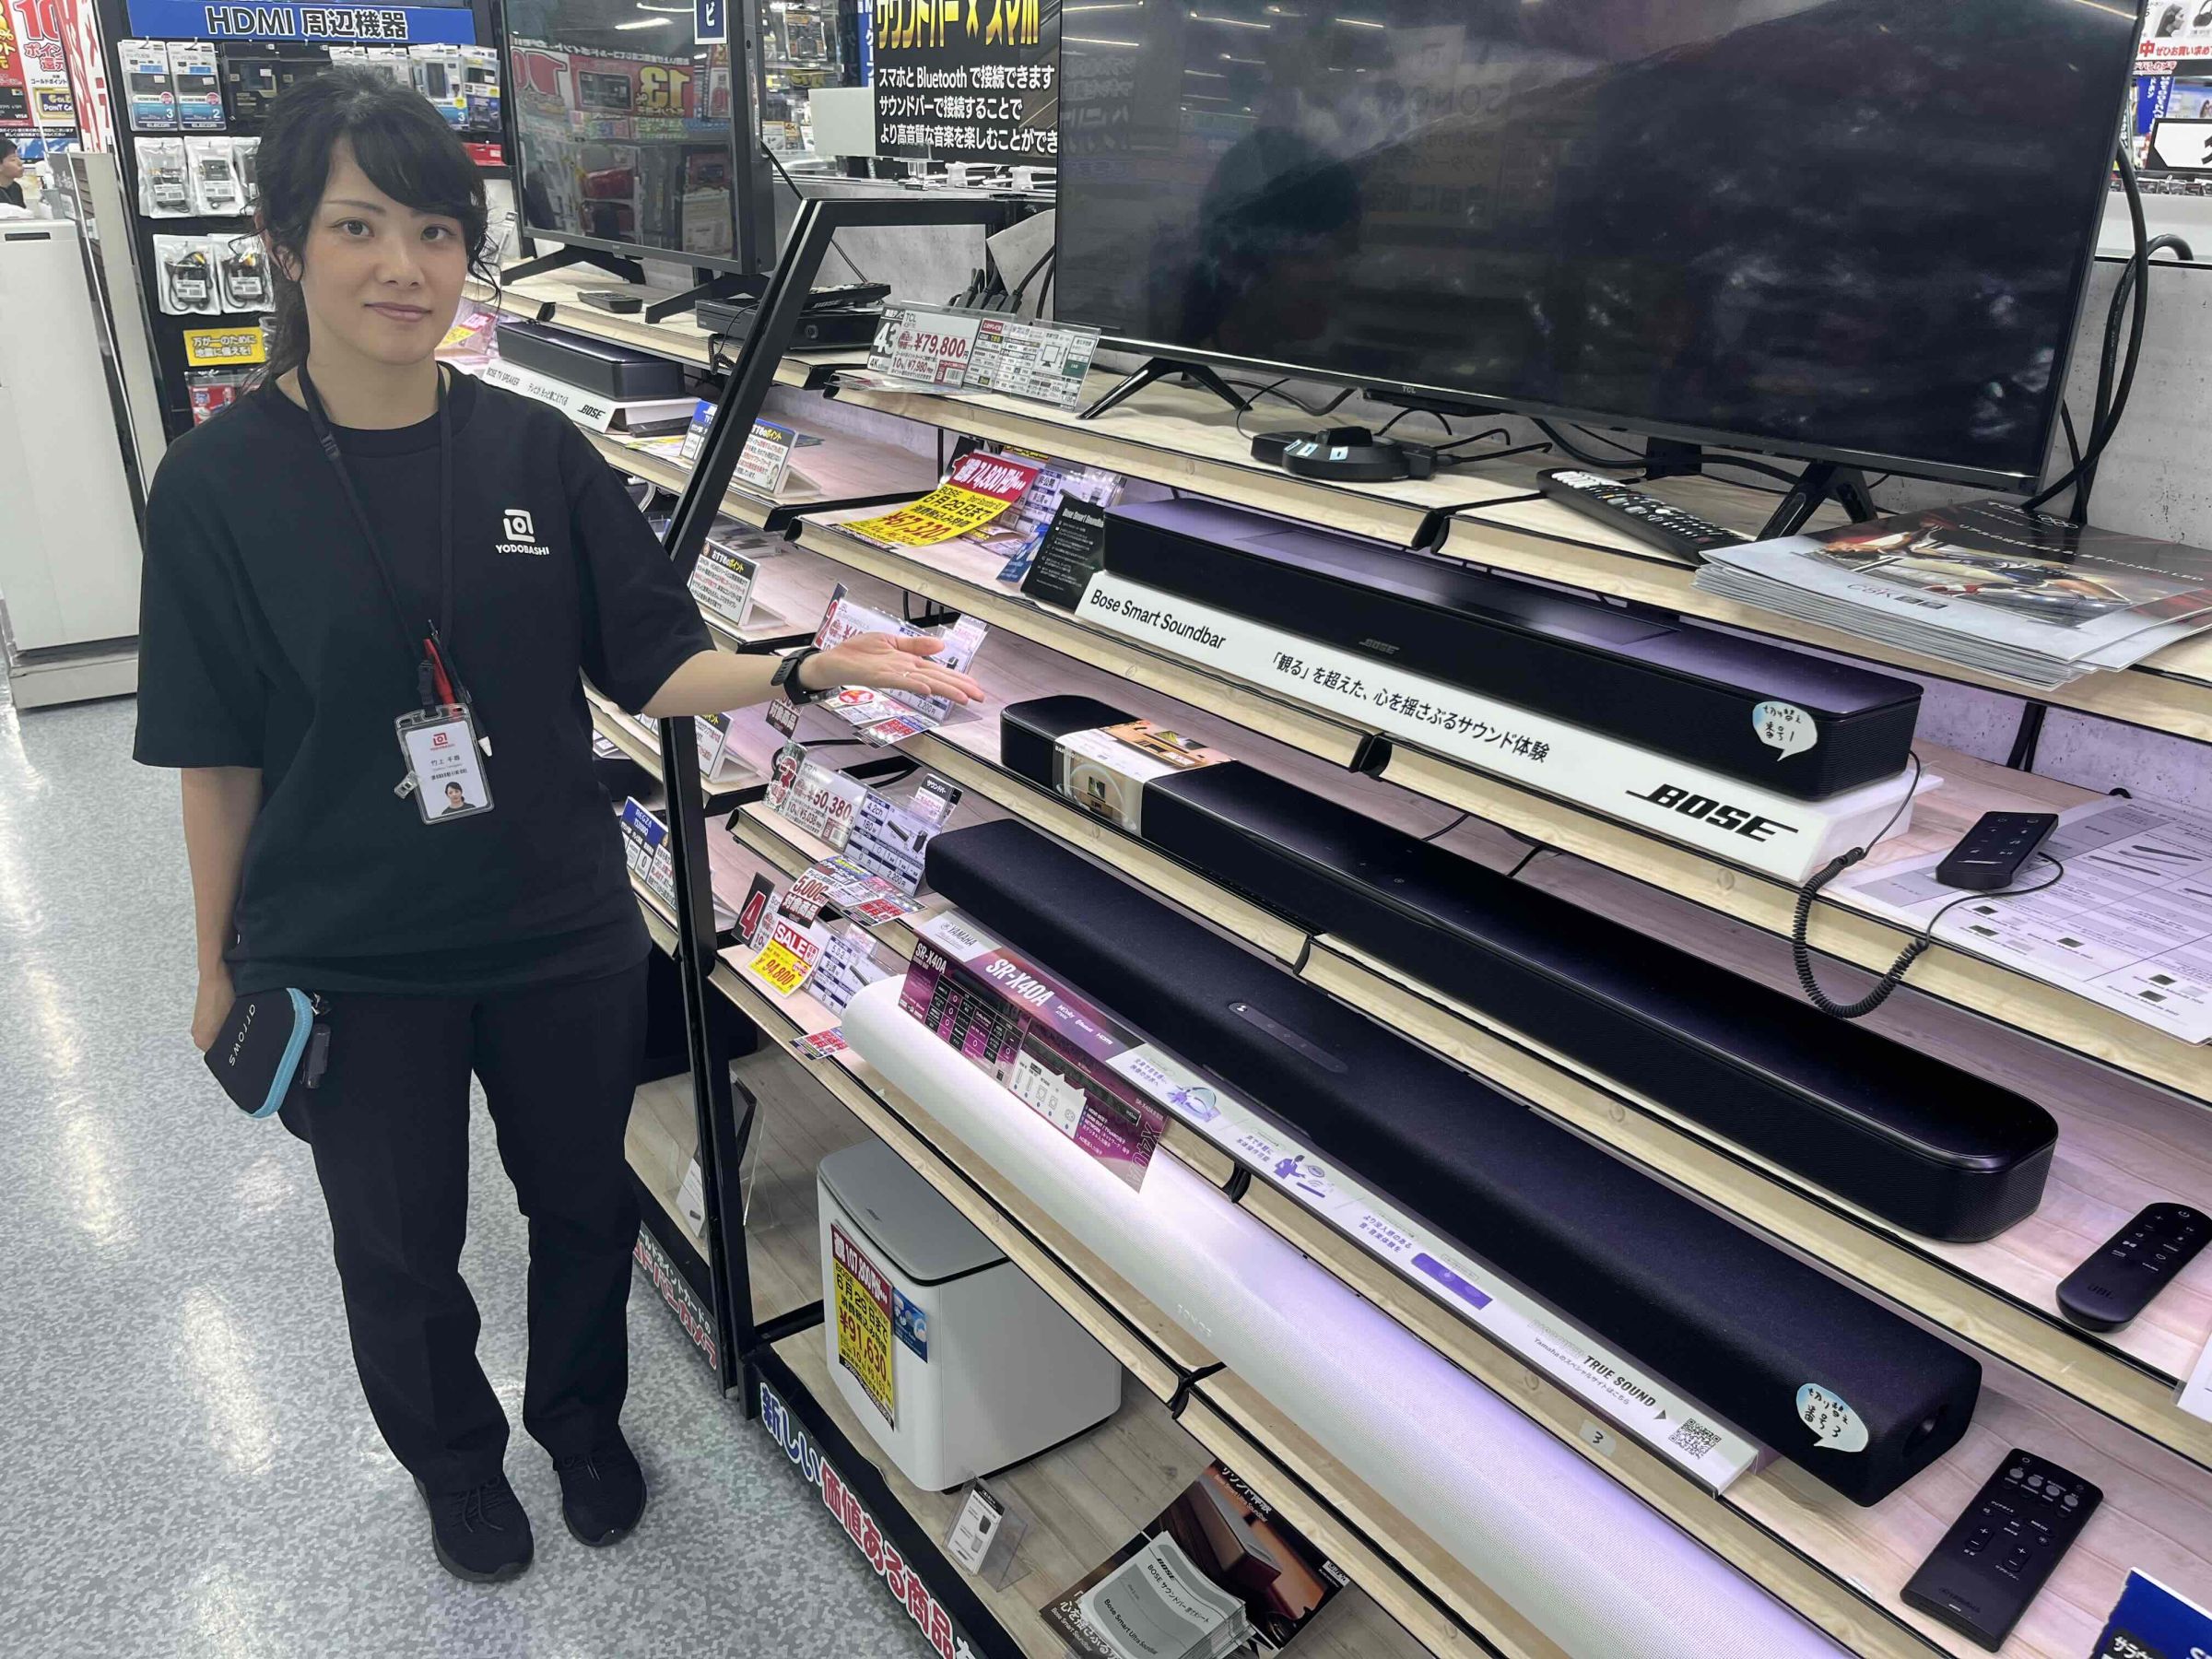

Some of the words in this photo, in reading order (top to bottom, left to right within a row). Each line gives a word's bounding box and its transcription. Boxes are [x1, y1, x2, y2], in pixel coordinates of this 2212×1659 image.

[207, 7, 295, 37] HDMI
[301, 7, 408, 39] 周辺機器
[879, 66, 914, 88] スマホと
[917, 65, 967, 88] Bluetooth
[970, 65, 1055, 89] で接続できます
[166, 108, 174, 118] 3
[212, 109, 221, 119] 2
[458, 112, 465, 122] 3
[879, 95, 1022, 121] サウンドバーで接続することで
[880, 124, 1058, 154] より高音質な音楽を楽しむことができ
[906, 312, 916, 323] TCL
[193, 335, 256, 347] 万が一のために
[874, 323, 900, 355] 43
[577, 405, 606, 419] BOSE
[495, 544, 549, 556] YODOBASHI
[1090, 589, 1120, 614] Bose
[1122, 599, 1161, 628] Smart
[1161, 614, 1227, 650] Soundbar
[1359, 639, 1400, 654] BOSE
[635, 808, 653, 829] REGZA
[1626, 783, 1799, 842] BOSE
[739, 890, 767, 939] 4
[774, 924, 807, 958] SALE
[948, 922, 977, 947] YAMAHA
[915, 943, 947, 974] SR-X40A
[986, 959, 1054, 1007] SR-X40A
[1583, 1354, 1616, 1382] TRUE
[1612, 1374, 1657, 1408] SOUND
[1593, 1431, 1604, 1443] 3
[1157, 1558, 1176, 1581] BOSE
[1147, 1564, 1162, 1583] BOSE
[1161, 1582, 1187, 1611] サウンドバー
[1104, 1598, 1117, 1616] Bose
[1114, 1612, 1132, 1635] Smart
[1128, 1629, 1142, 1645] Ultra
